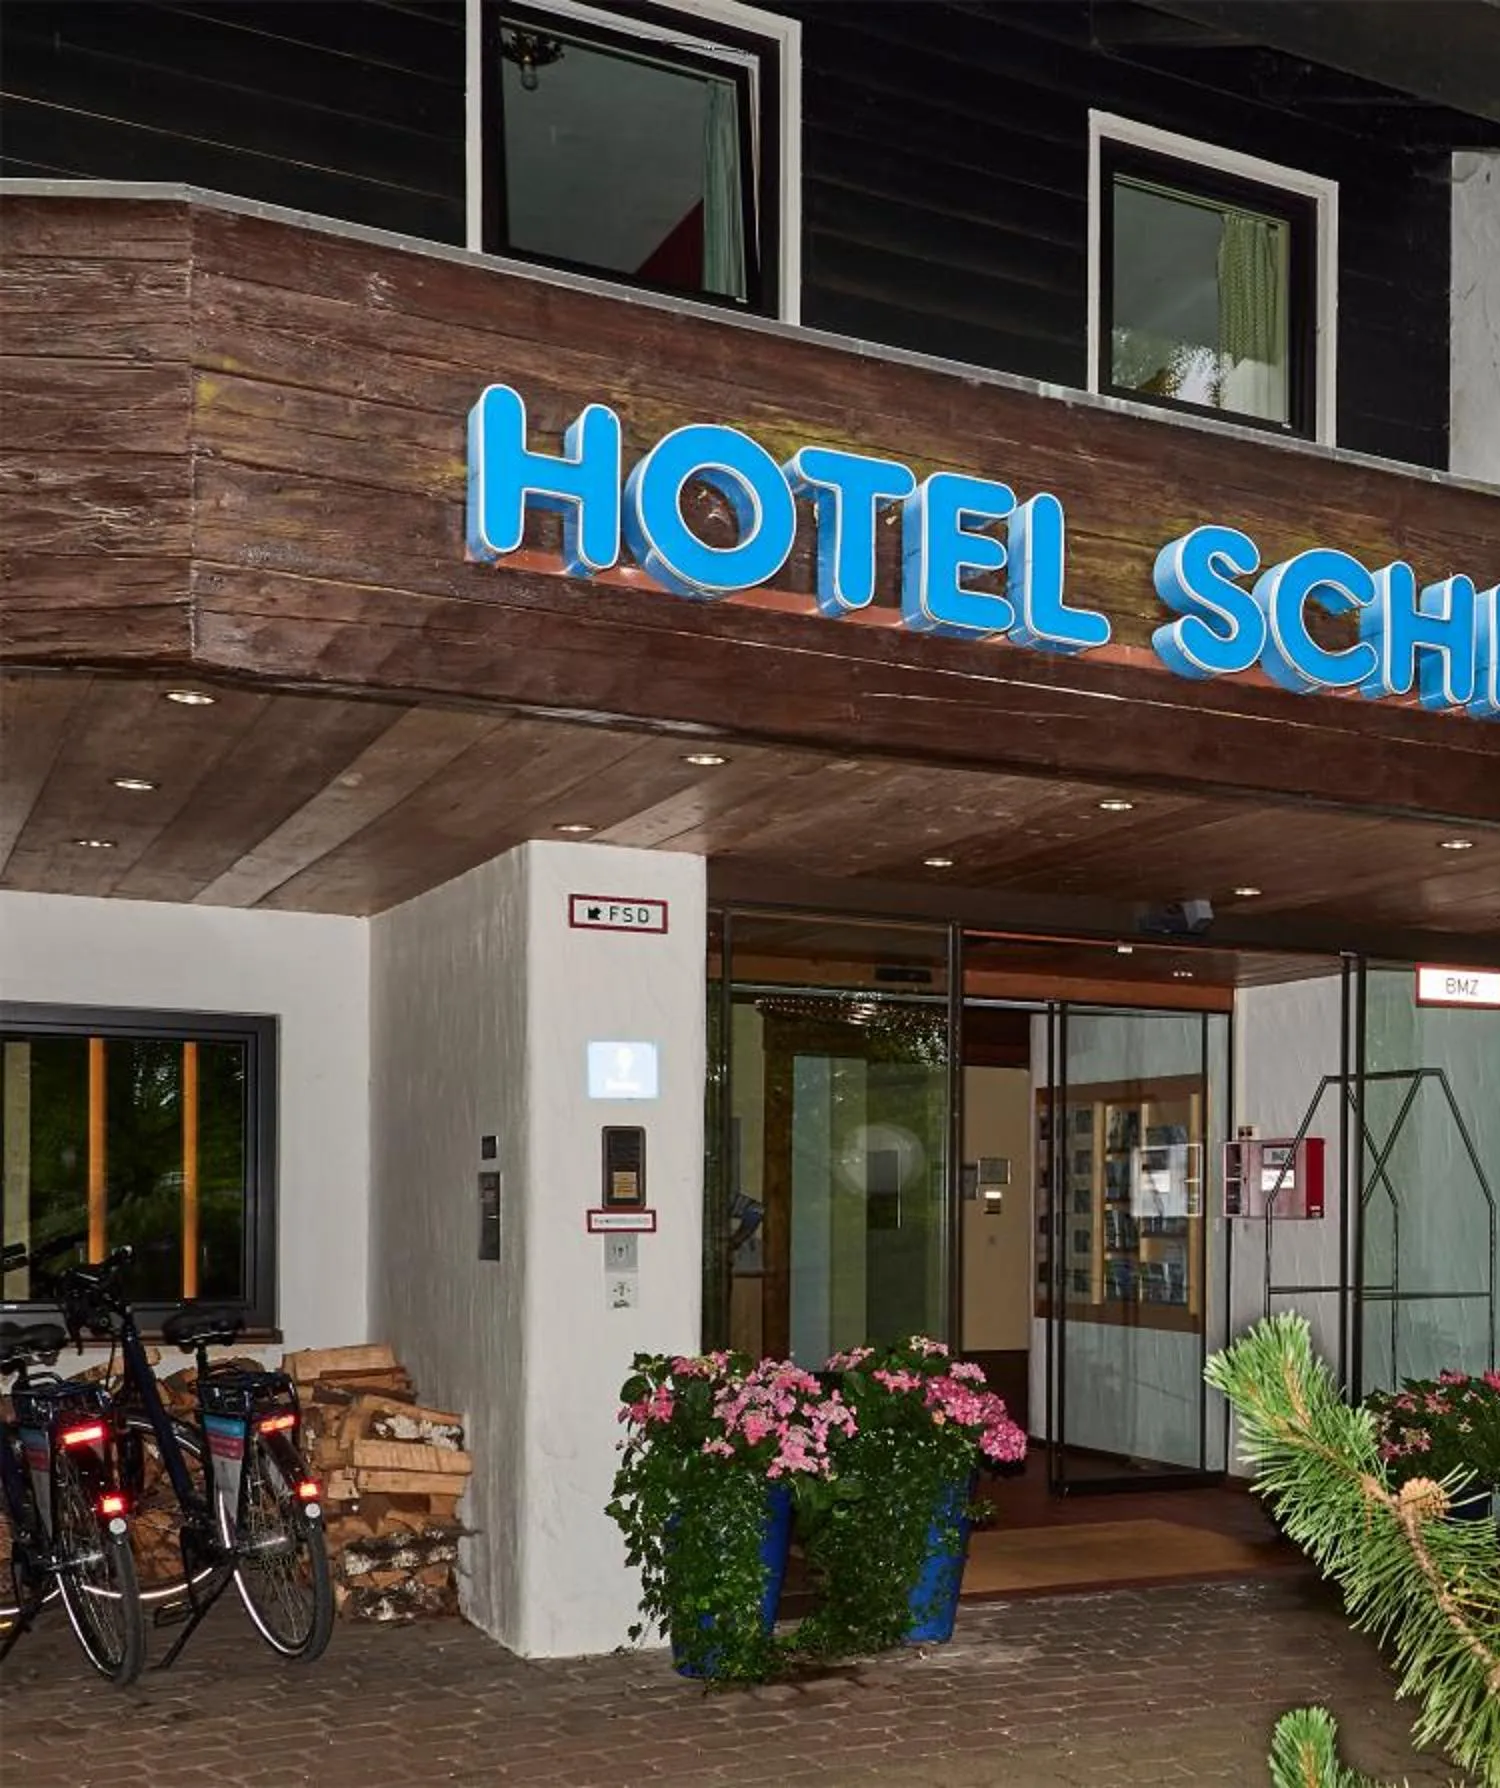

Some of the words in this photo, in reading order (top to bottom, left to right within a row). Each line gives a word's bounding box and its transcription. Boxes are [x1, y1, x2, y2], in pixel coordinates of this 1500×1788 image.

[467, 383, 1111, 655] HOTEL
[609, 905, 649, 923] FSD
[1445, 977, 1479, 996] BMZ
